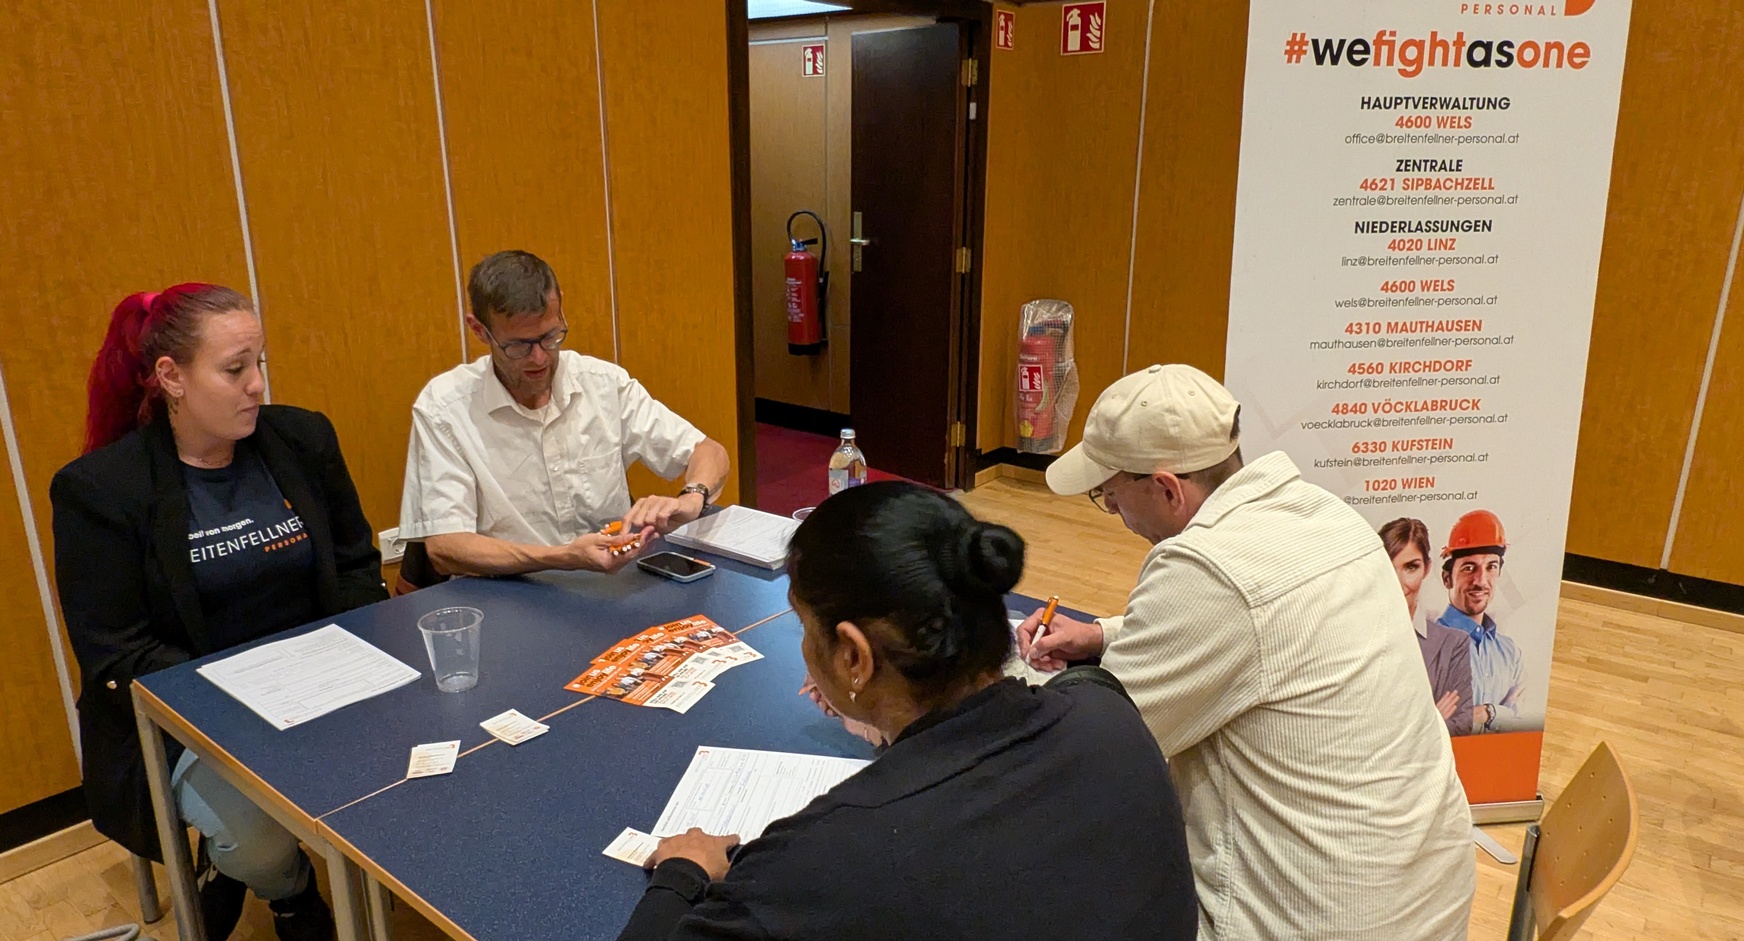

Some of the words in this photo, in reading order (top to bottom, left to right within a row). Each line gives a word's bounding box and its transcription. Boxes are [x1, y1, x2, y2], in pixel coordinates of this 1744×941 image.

[1460, 3, 1557, 16] PERSONAL
[1284, 30, 1591, 78] #wefightasone
[1360, 96, 1511, 110] HAUPTVERWALTUNG
[1395, 116, 1432, 129] 4600
[1436, 116, 1473, 129] WELS
[1344, 133, 1520, 146] office@breitenfellner-personal.at
[1395, 159, 1463, 173] ZENTRALE
[1359, 177, 1396, 191] 4621
[1402, 177, 1495, 191] SIPBACHZELL
[1333, 194, 1519, 207] zentrale@breitenfellner-personal.at
[1354, 220, 1493, 234] NIEDERLASSUNGEN
[1387, 239, 1424, 252] 4020
[1427, 238, 1457, 251] LINZ
[1341, 253, 1499, 267] linz@breitenfellner-personal.at
[1380, 280, 1417, 293] 4600
[1419, 279, 1455, 292] WELS
[1334, 294, 1498, 308] wels@breitenfellner-personal.at
[1344, 321, 1382, 335] 4310
[1386, 319, 1483, 334] MAUTHAUSEN
[1309, 334, 1515, 350] mauthausen@breitenfellner-personal.at
[1347, 362, 1384, 375] 4560
[1388, 359, 1473, 374] KIRCHDORF
[1316, 375, 1501, 390] kirchdorf@breitenfellner-personal.at
[1331, 402, 1368, 416] 4840
[1371, 398, 1481, 414] VÖCKLABRUCK
[1300, 413, 1508, 430] voecklabruck@breitenfellner-personal.at
[1351, 441, 1388, 454] 6330
[1391, 438, 1454, 453] KUFSTEIN
[1314, 453, 1489, 468] kufstein@breitenfellner-personal.at
[1364, 479, 1398, 492] 1020
[1400, 477, 1436, 490] WIEN
